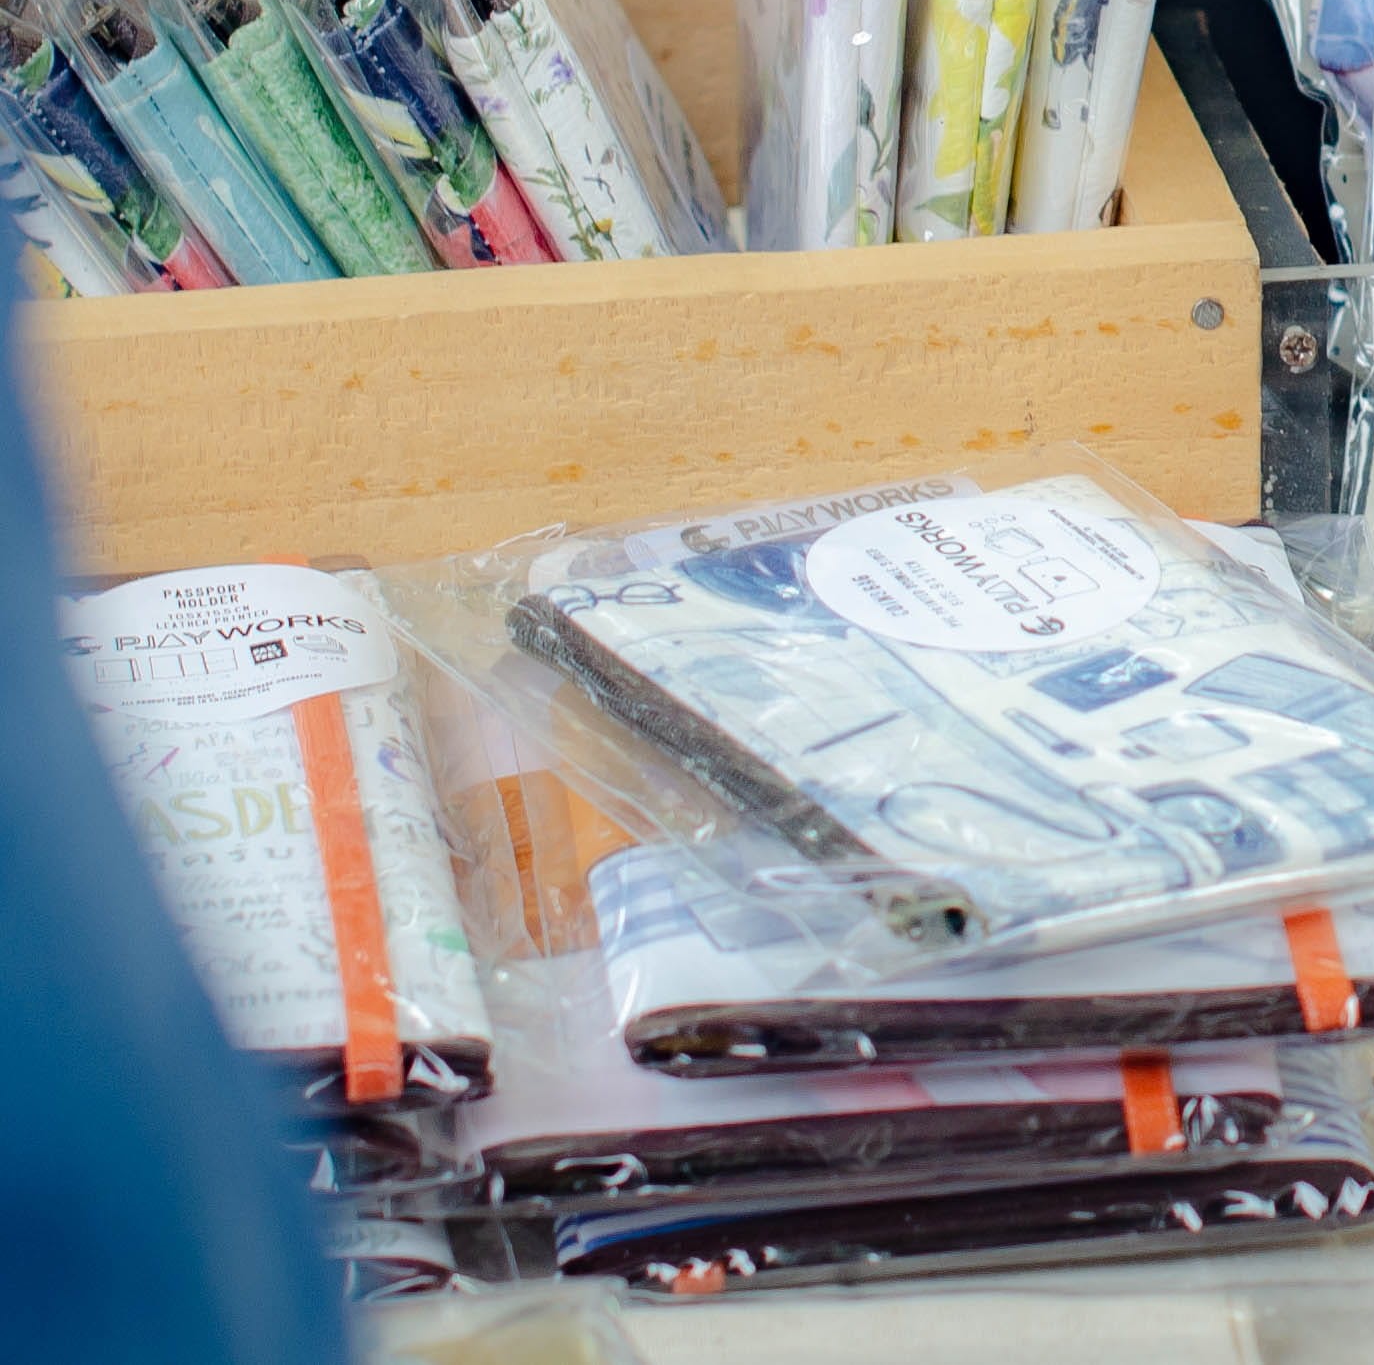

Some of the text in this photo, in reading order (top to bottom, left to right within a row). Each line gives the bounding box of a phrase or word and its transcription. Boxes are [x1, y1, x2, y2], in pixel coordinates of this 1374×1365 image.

[163, 581, 246, 599] PASSPORT
[178, 594, 240, 609] HOLDER
[156, 610, 269, 630] LEATHER PRINTED
